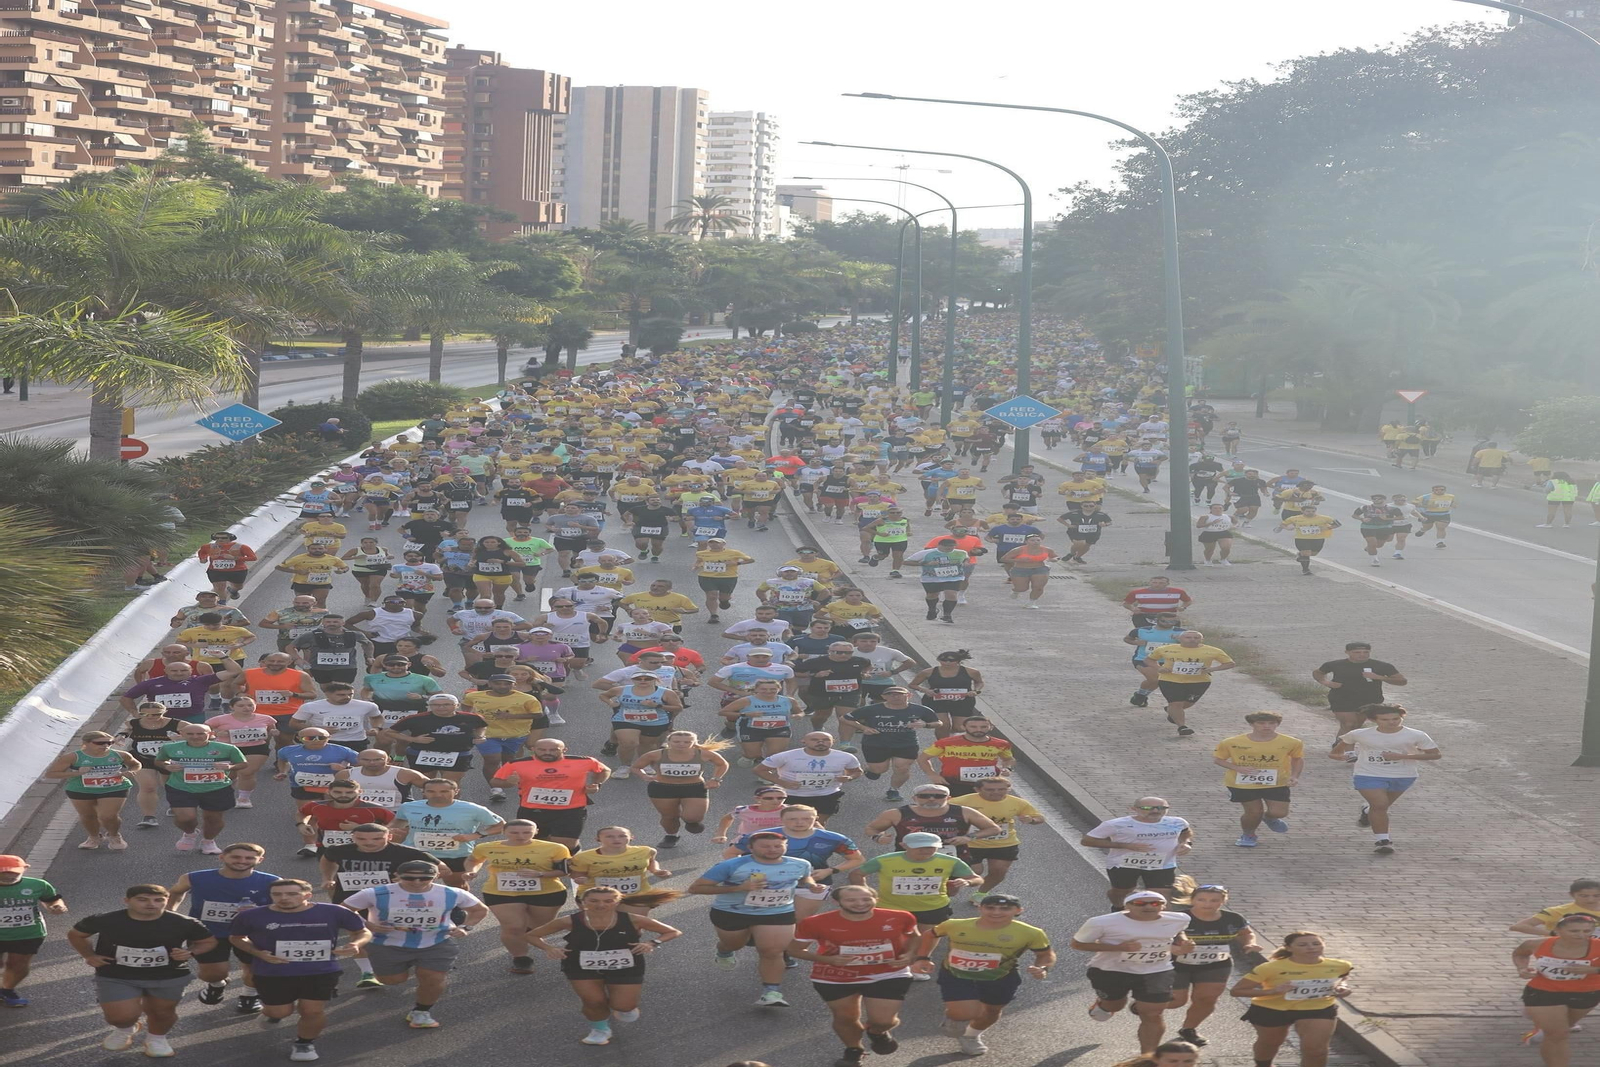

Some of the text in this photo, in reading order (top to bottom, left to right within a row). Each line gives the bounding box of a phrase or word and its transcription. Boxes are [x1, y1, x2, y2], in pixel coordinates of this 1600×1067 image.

[420, 756, 453, 764] 2025
[192, 772, 218, 780] 123
[91, 778, 116, 786] 125
[298, 778, 331, 786] 2217
[533, 794, 568, 803] 1403
[418, 839, 456, 847] 1524
[341, 859, 391, 872] LEONE
[344, 878, 390, 886] 10768
[500, 879, 537, 887] 7539
[749, 894, 790, 903] 11275
[0, 914, 32, 923] 296
[393, 916, 437, 924] 2018
[282, 949, 325, 958] 1381
[851, 953, 884, 962] 201
[1127, 951, 1167, 960] 7756
[1182, 952, 1226, 960] 11501
[121, 955, 165, 964] 1796
[585, 958, 631, 967] 2823
[957, 960, 989, 968] 202
